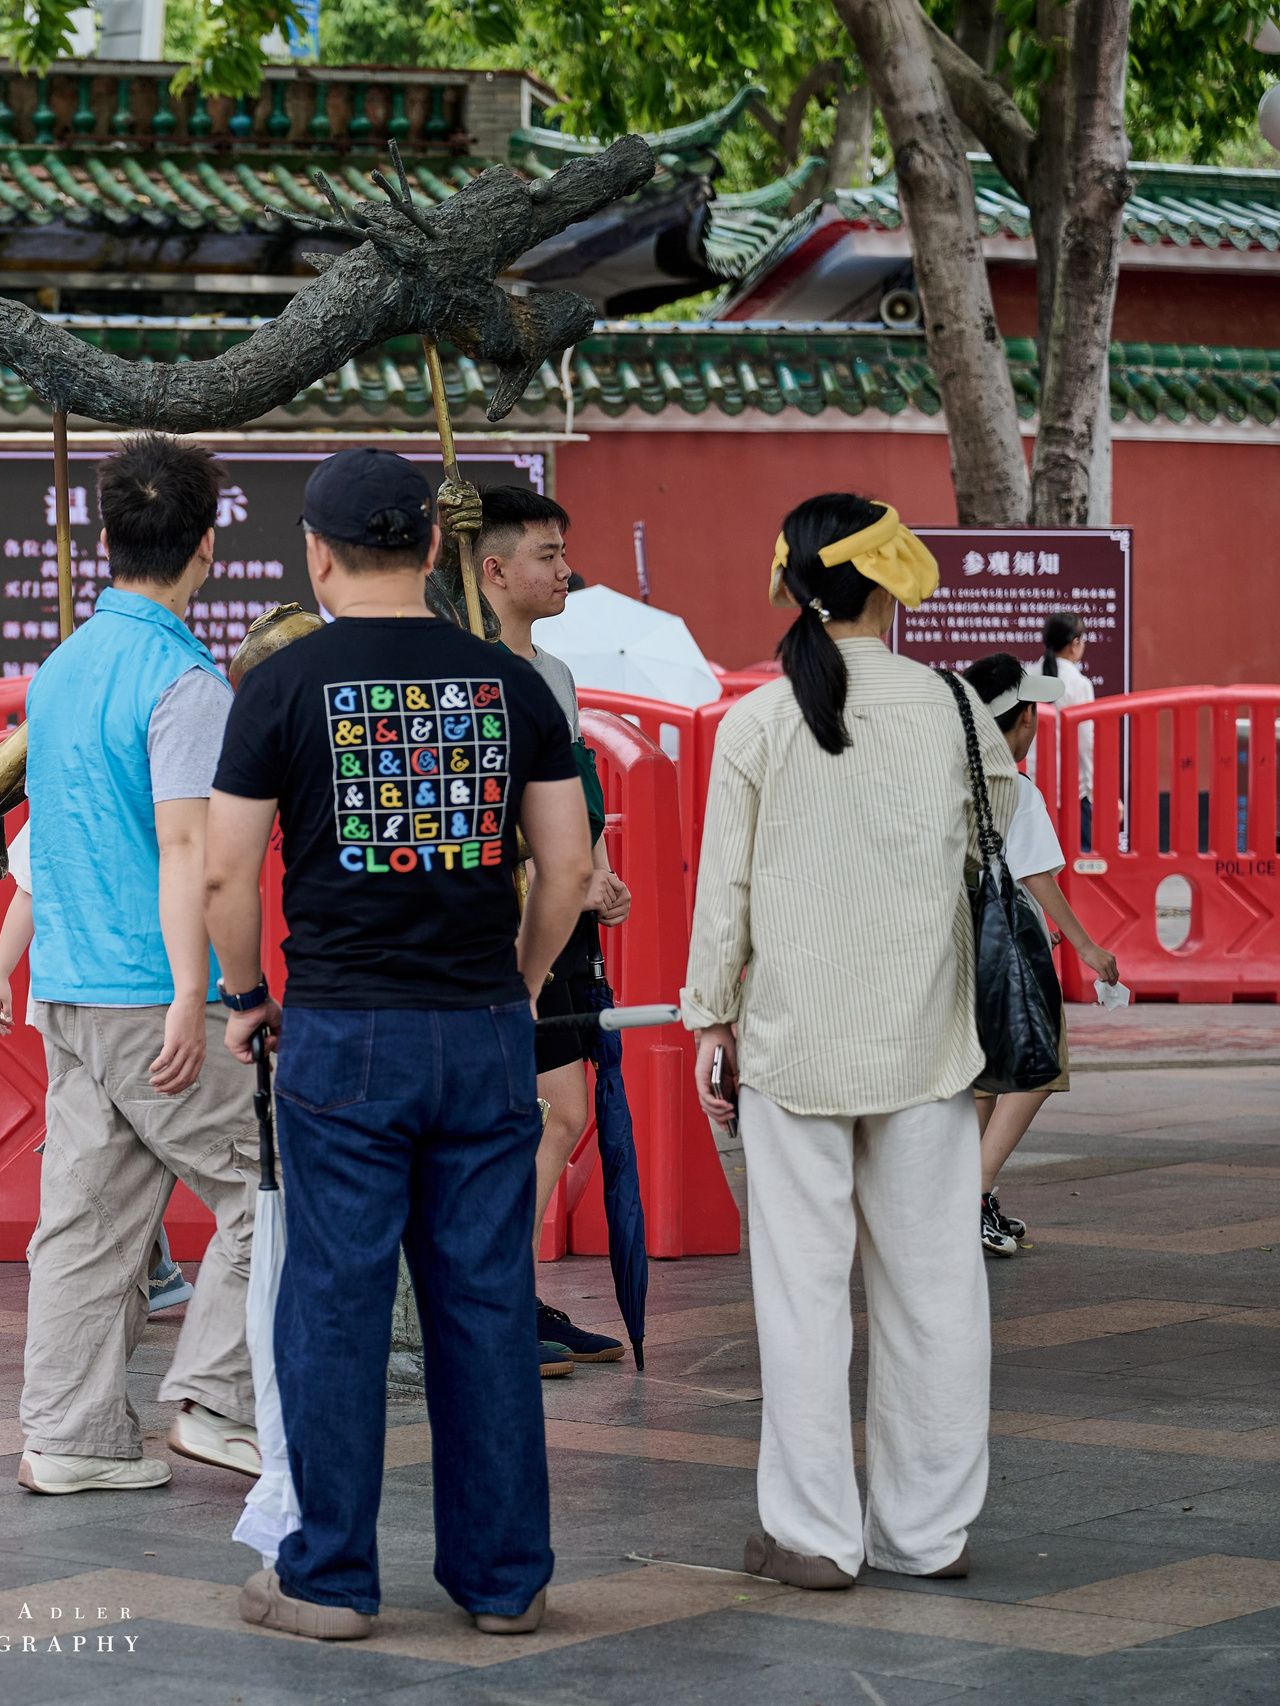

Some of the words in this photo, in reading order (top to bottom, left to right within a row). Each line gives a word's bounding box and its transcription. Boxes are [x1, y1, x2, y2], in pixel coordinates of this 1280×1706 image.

[962, 550, 1060, 576] 参观须知
[339, 840, 502, 873] CLOTTEE
[1216, 860, 1276, 876] POLICE
